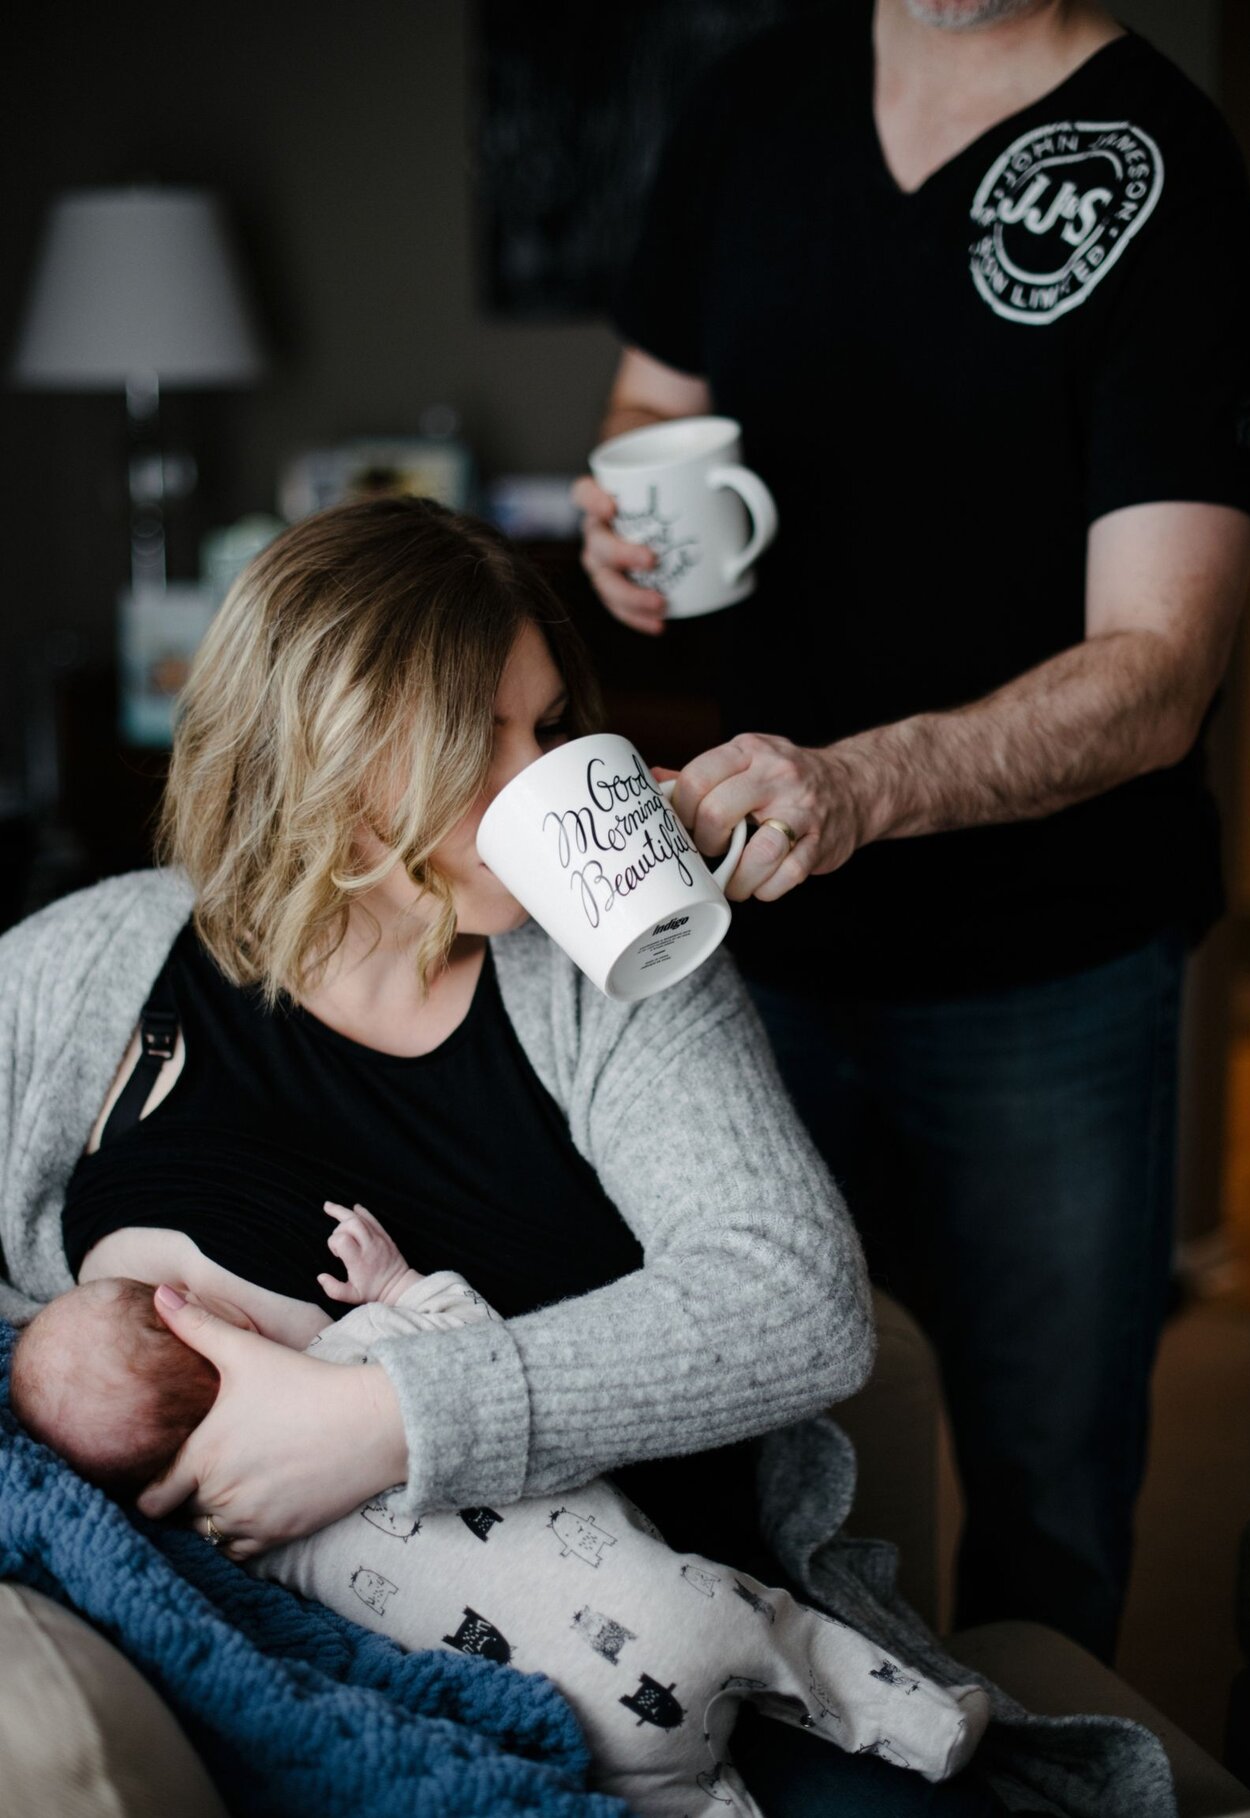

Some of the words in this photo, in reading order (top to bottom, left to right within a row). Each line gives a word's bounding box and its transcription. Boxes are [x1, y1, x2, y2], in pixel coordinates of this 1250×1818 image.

[586, 753, 663, 813] Good
[542, 794, 670, 869] Morning
[570, 807, 699, 929] Beautiful
